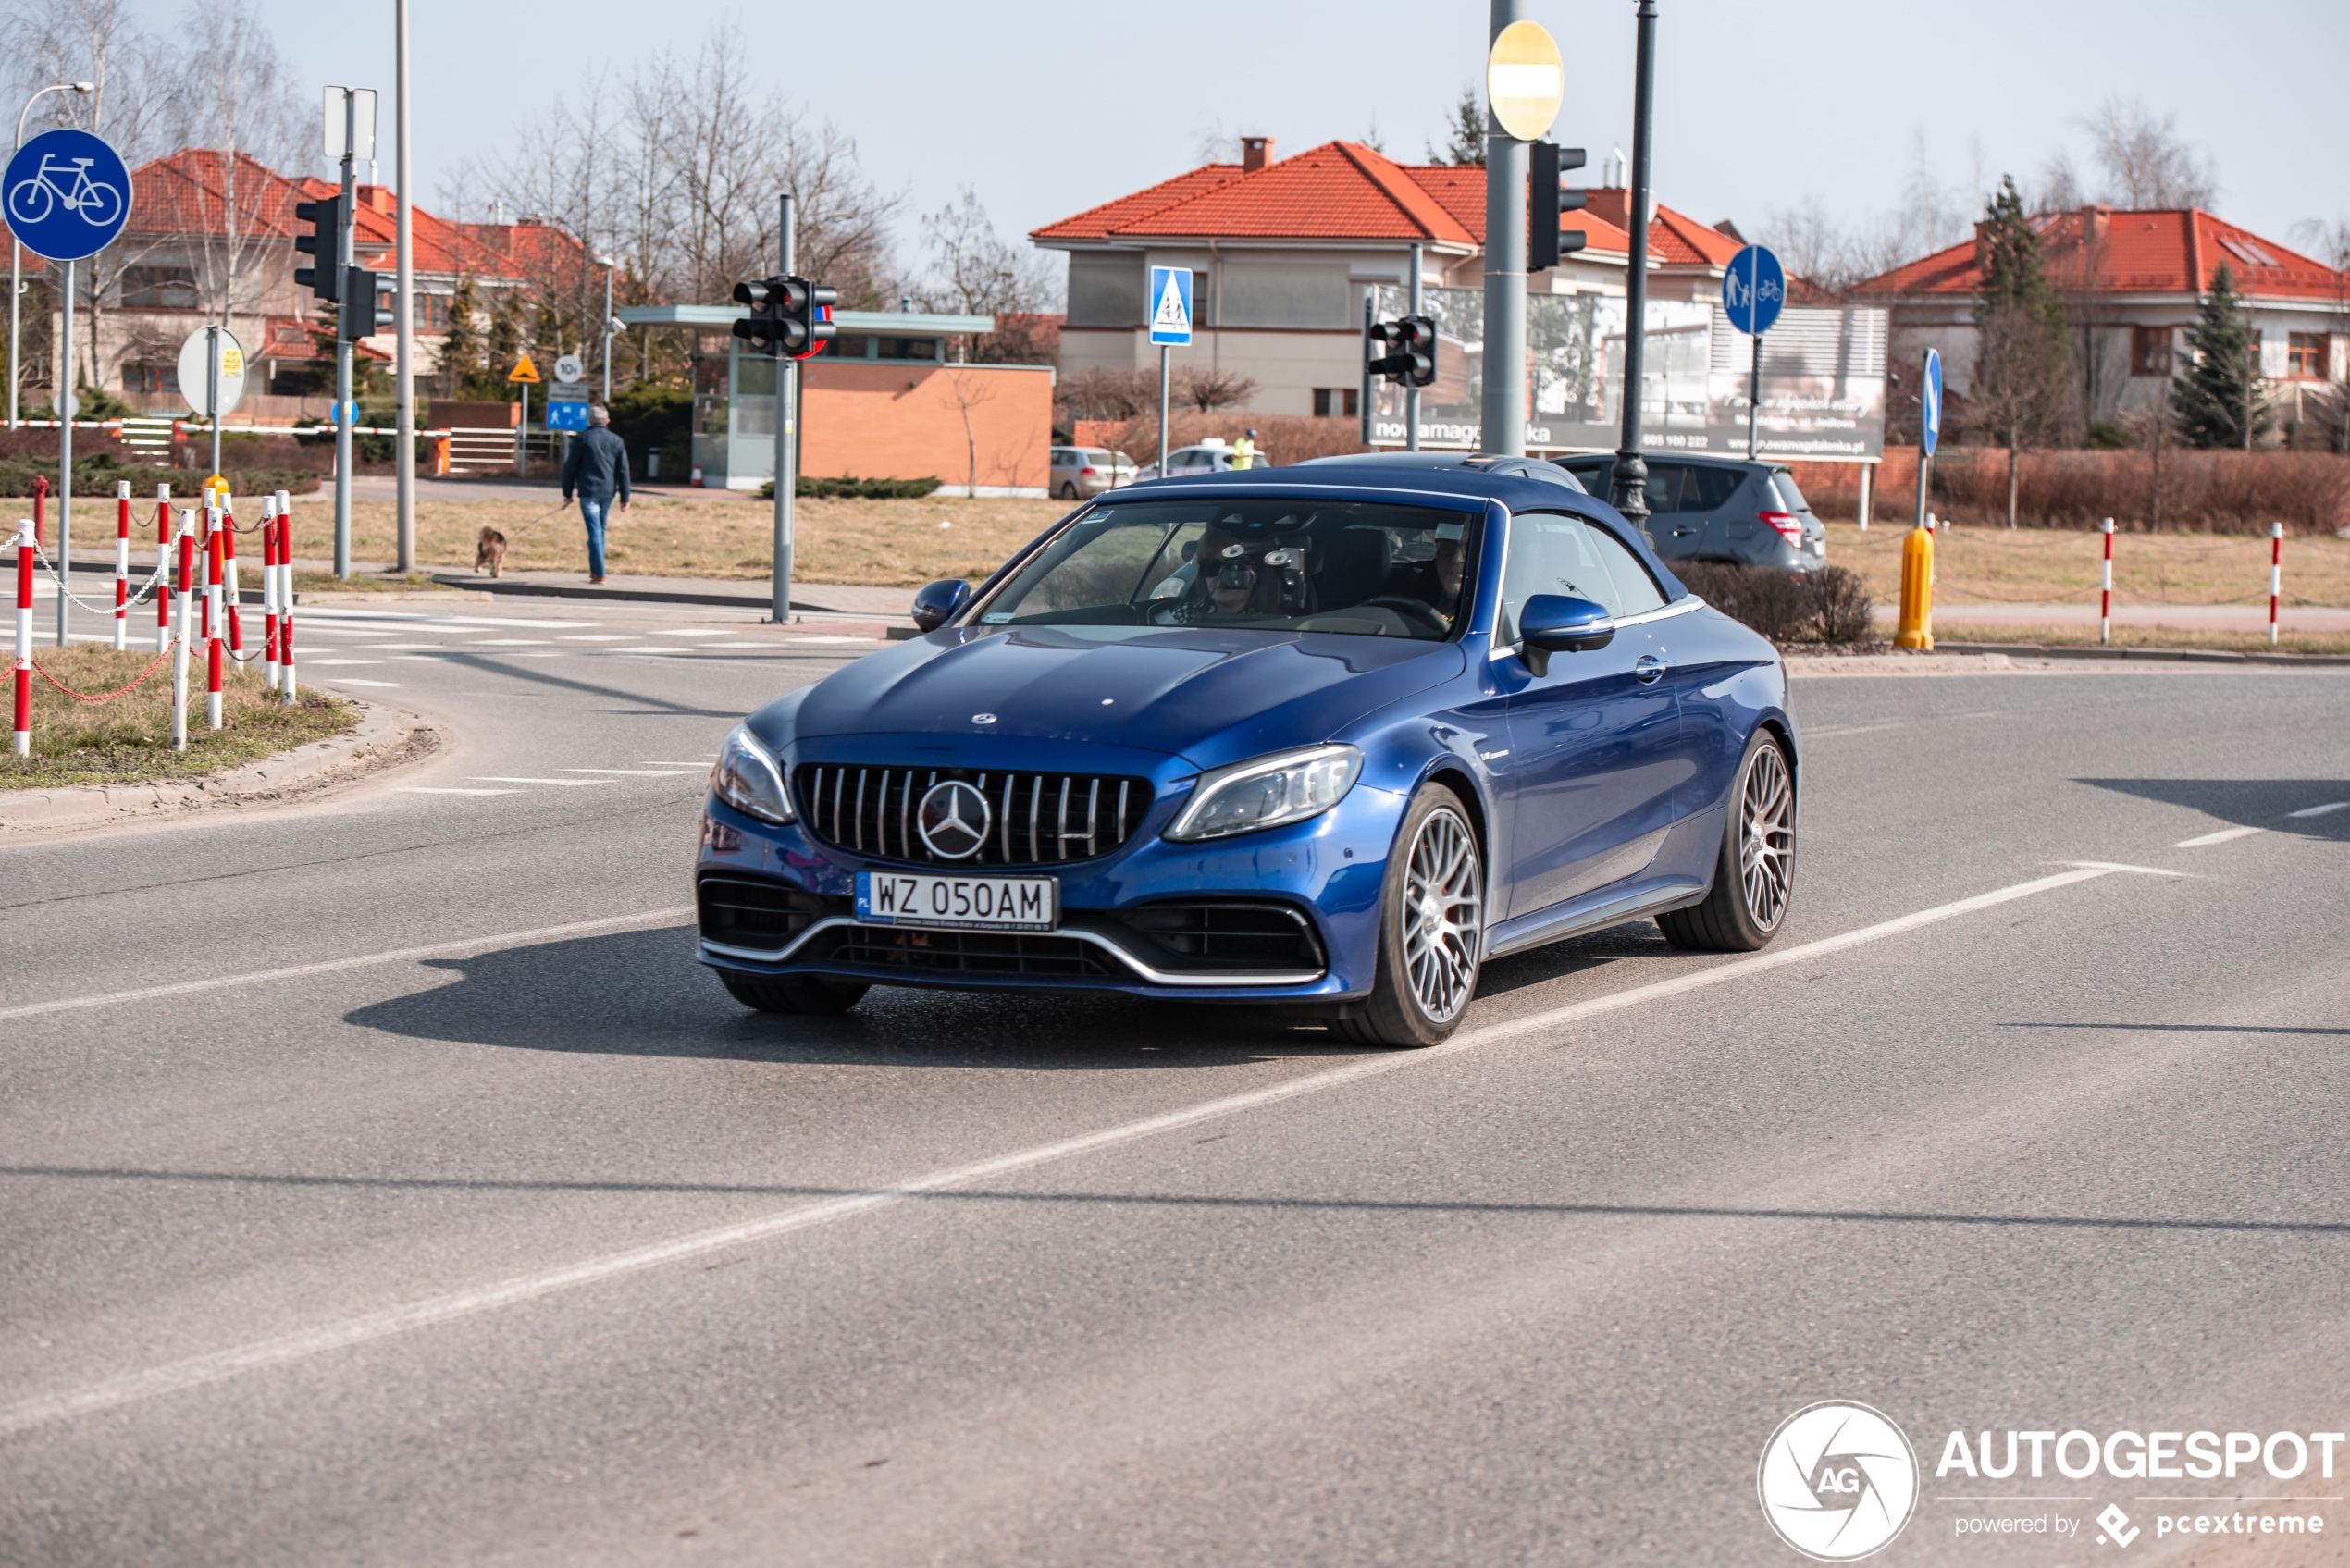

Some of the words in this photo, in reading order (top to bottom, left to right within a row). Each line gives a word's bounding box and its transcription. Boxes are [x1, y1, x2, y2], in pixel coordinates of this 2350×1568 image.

[858, 897, 870, 907] PL
[878, 877, 918, 914] WZ
[933, 881, 1041, 920] 050AM
